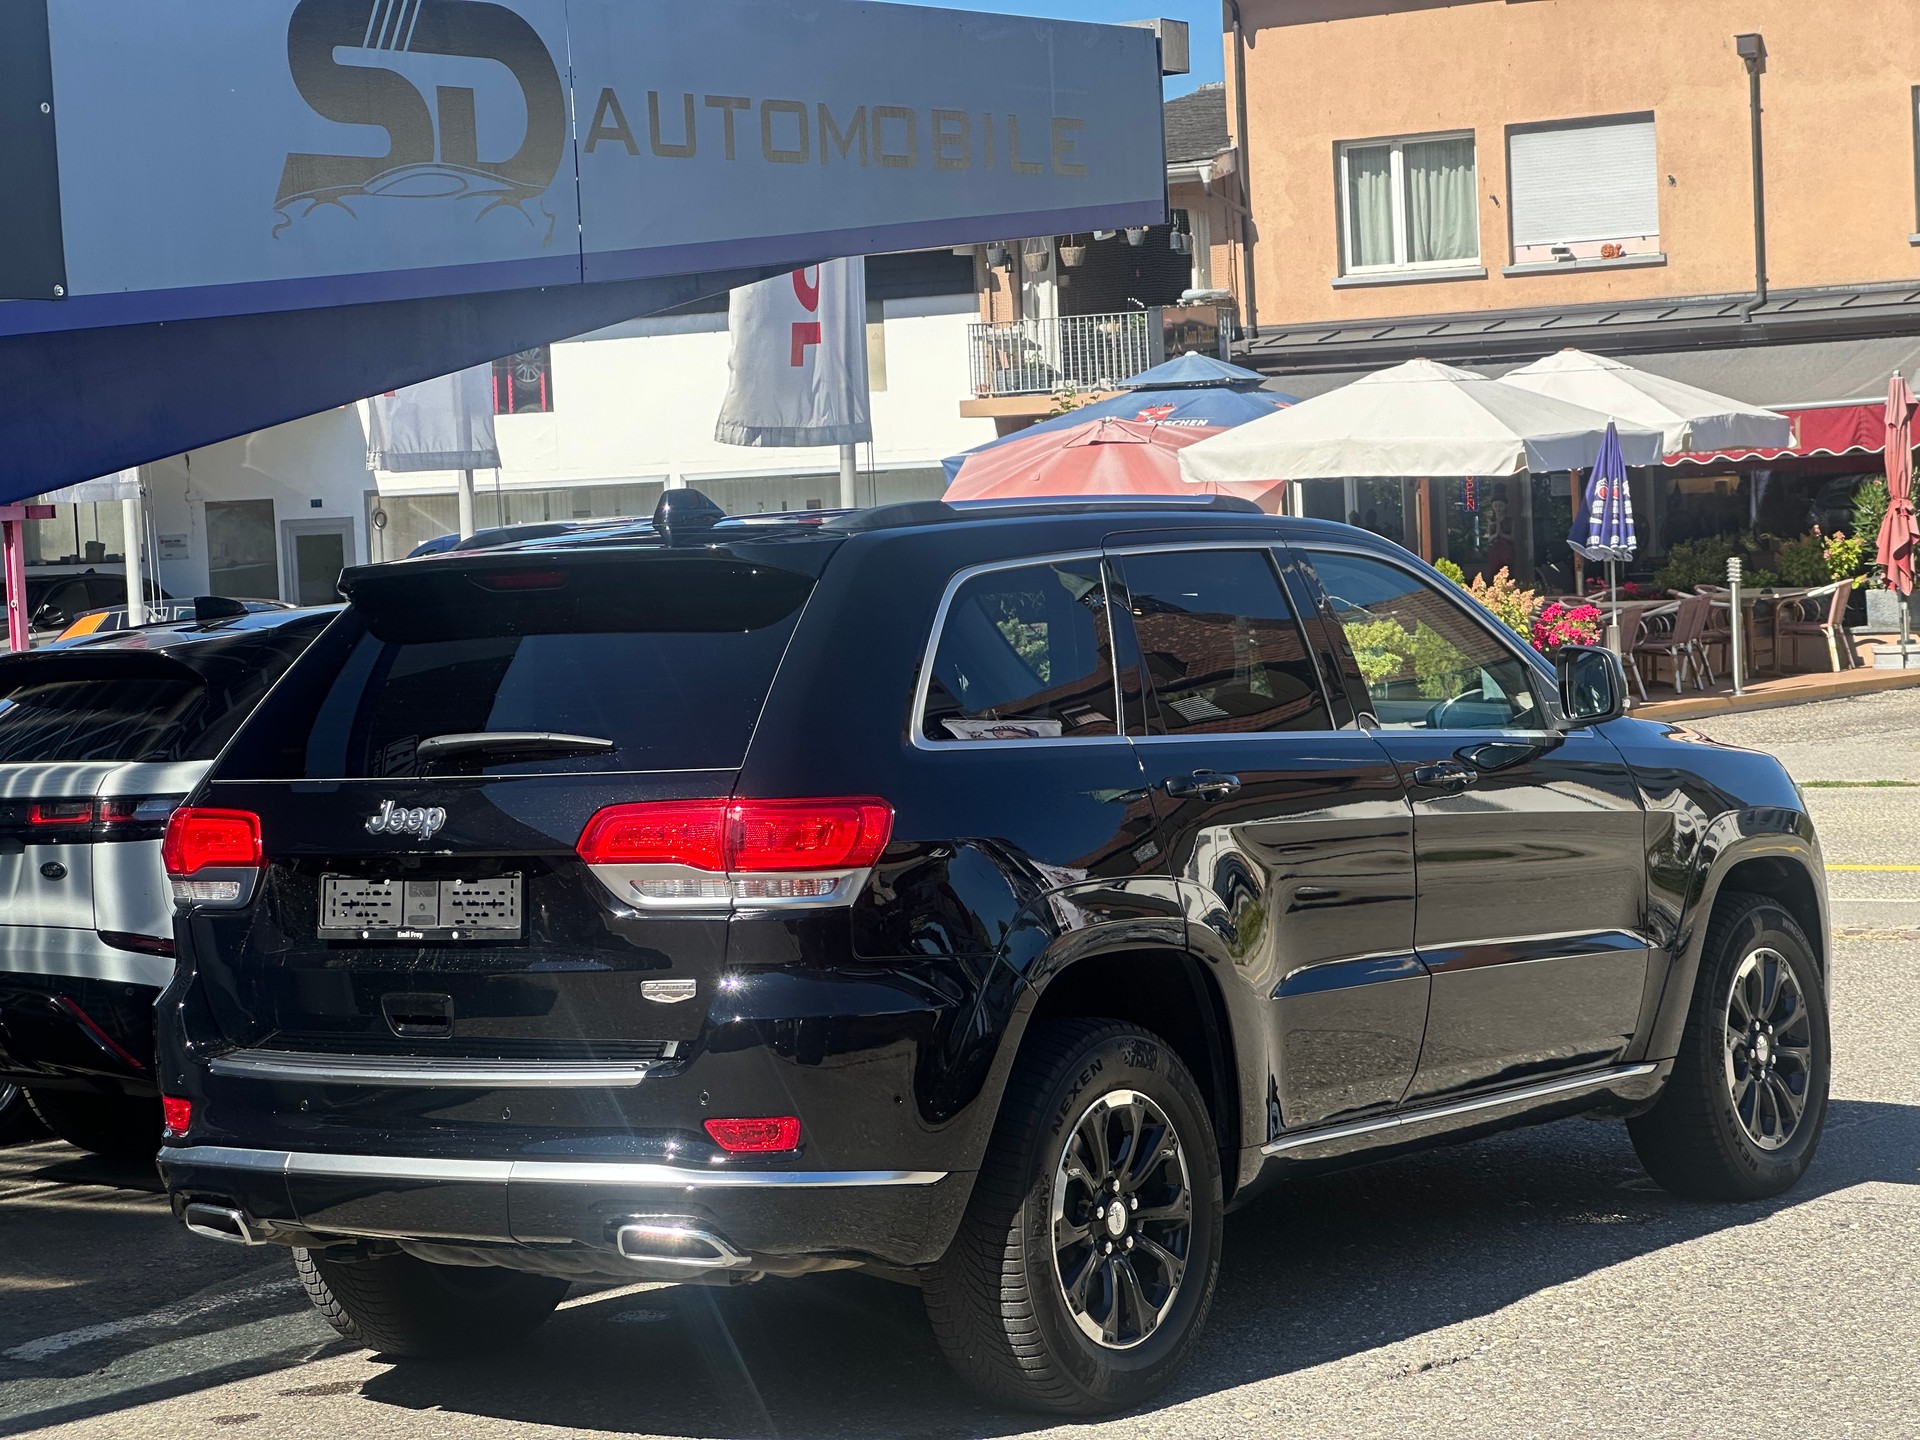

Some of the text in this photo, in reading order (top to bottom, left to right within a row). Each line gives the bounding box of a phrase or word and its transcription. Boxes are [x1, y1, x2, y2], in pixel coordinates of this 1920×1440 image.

[583, 86, 1088, 177] AUTOMOBILE
[365, 799, 447, 841] Jeep
[1050, 1058, 1104, 1137] NEXEN
[1725, 1108, 1759, 1172] NEXEN
